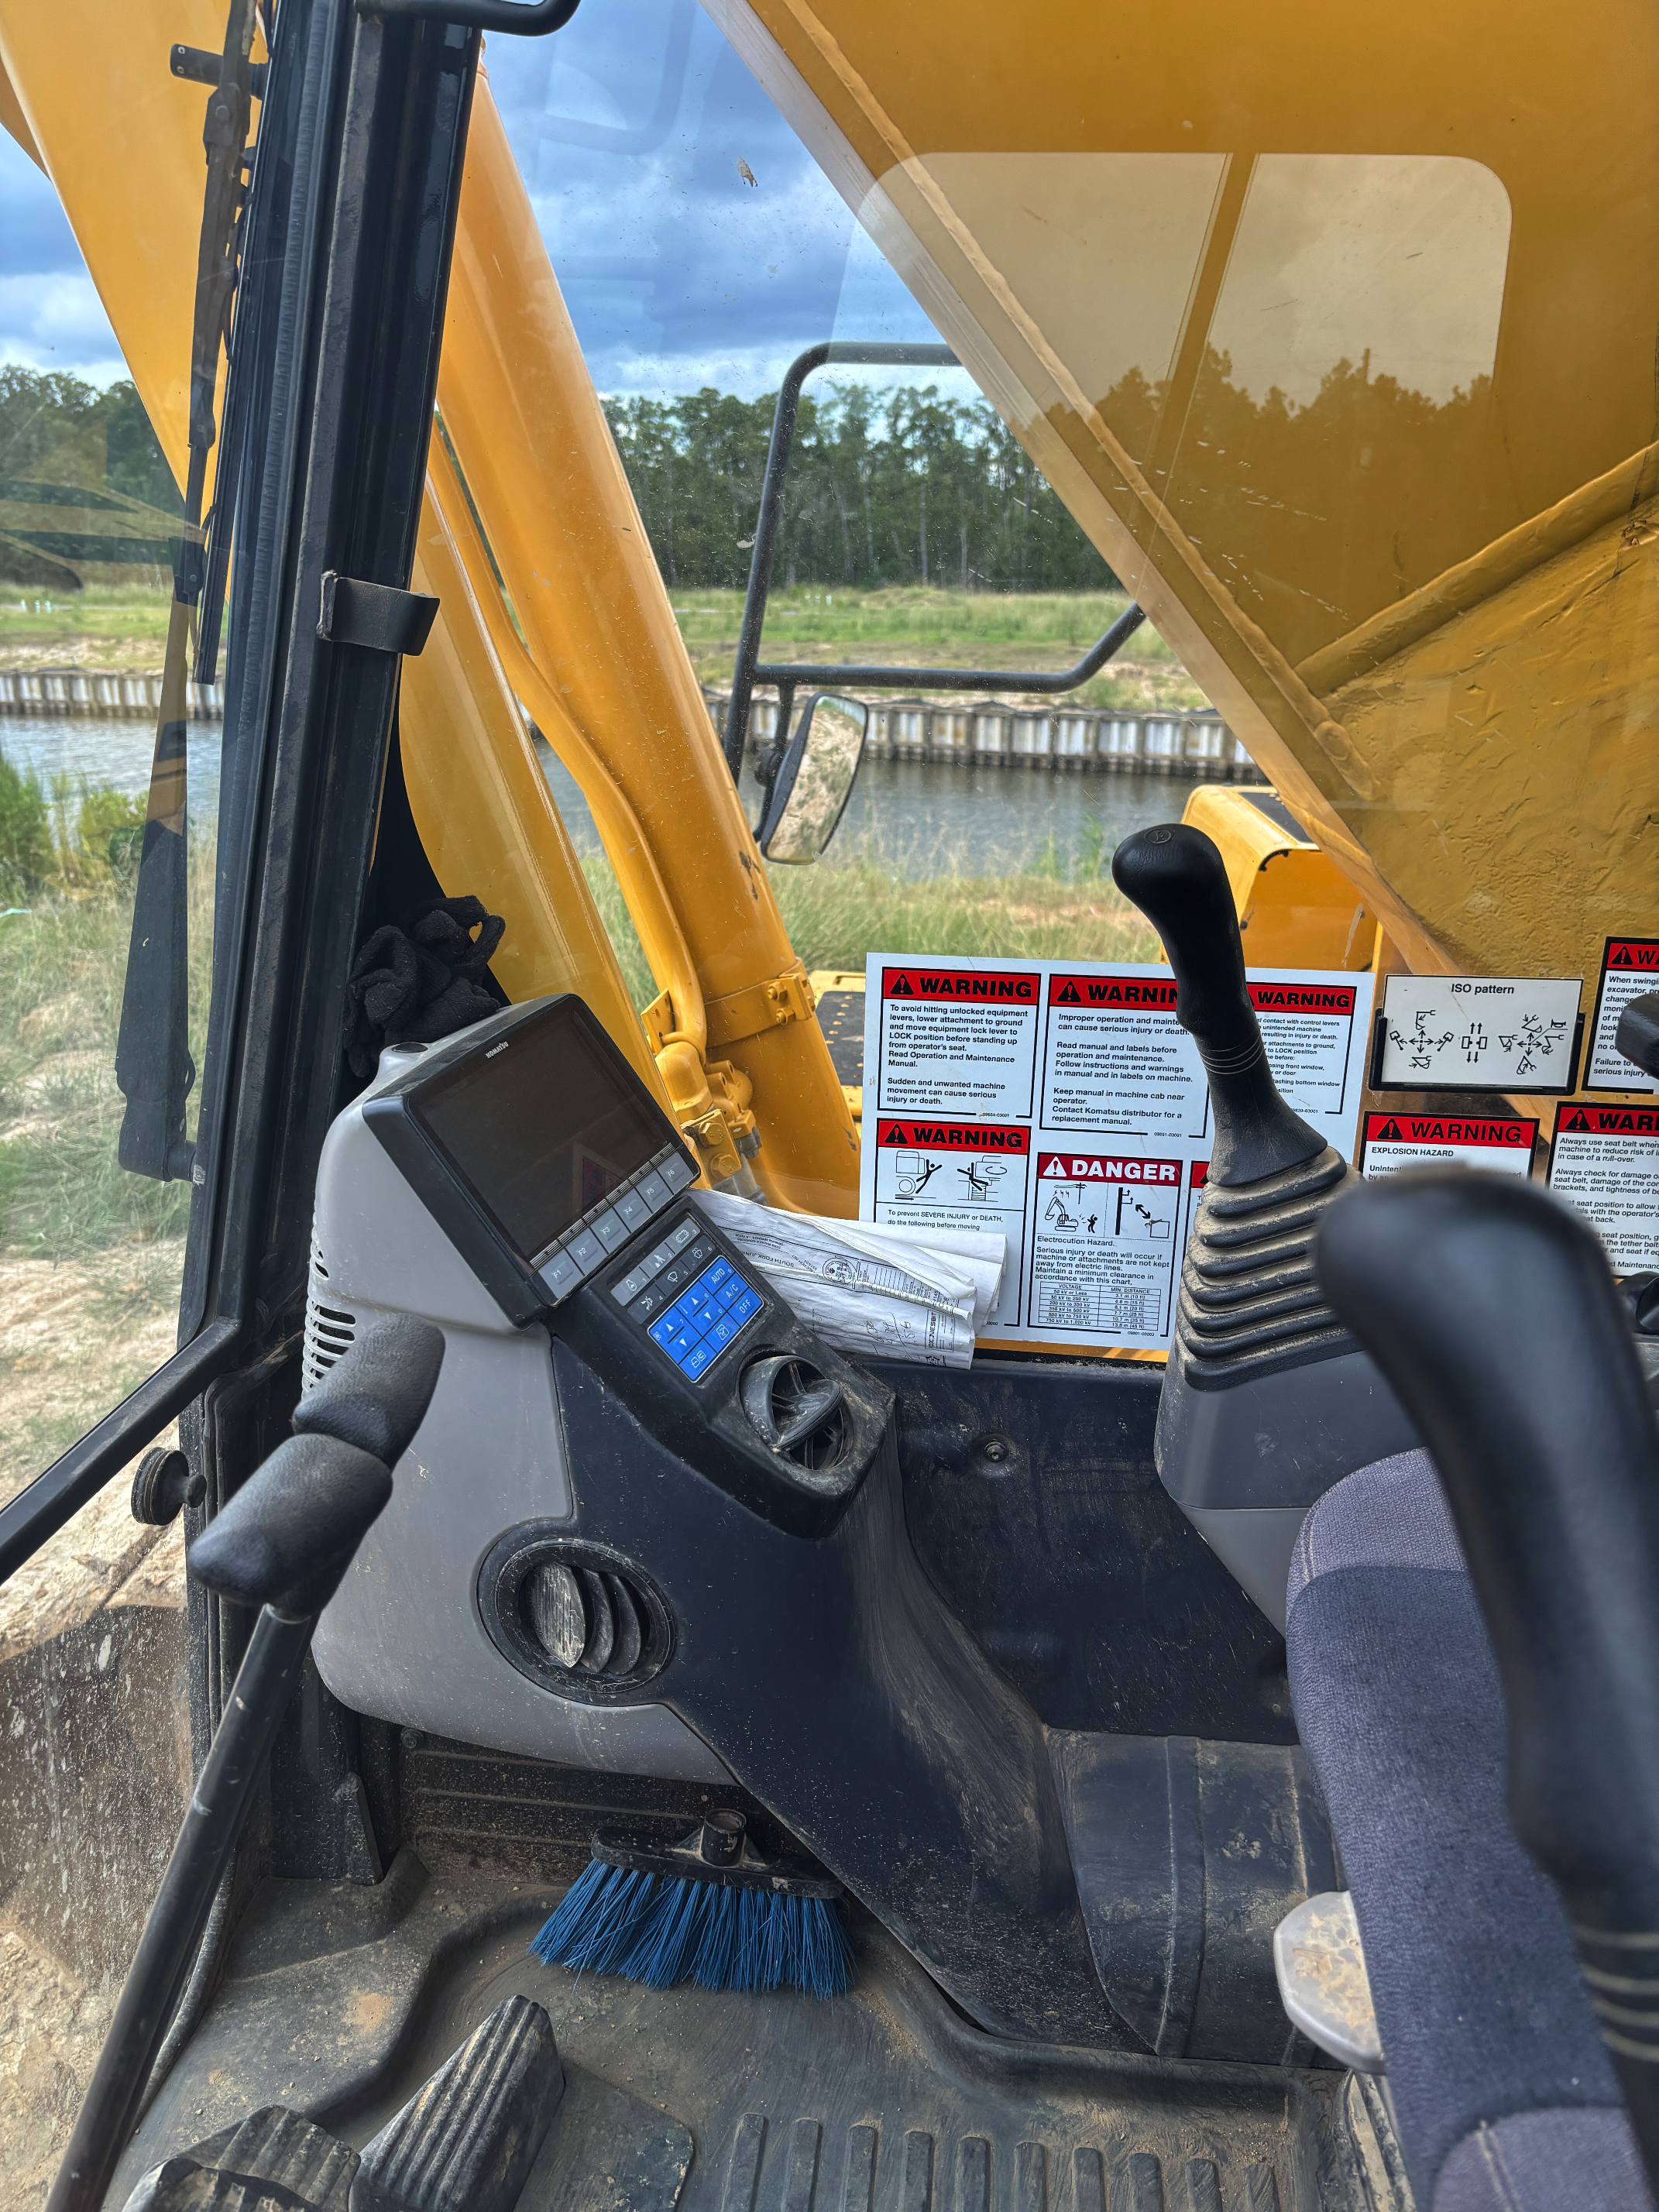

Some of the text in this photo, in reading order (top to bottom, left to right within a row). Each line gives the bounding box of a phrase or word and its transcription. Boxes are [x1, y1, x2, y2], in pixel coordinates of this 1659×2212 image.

[919, 978, 1031, 998] WARNING
[1451, 984, 1514, 995] ISO pattern
[1606, 986, 1647, 994] excavator,
[1087, 985, 1177, 1004] WARNIN
[1256, 991, 1349, 1007] WARNING
[923, 1006, 947, 1015] hitting
[890, 1014, 914, 1022] levers,
[1059, 1014, 1094, 1023] Improper
[928, 1025, 968, 1034] equipment
[1130, 1026, 1152, 1035] injury
[972, 1036, 1005, 1046] standing
[486, 1041, 509, 1058] KOMATSU
[910, 1052, 947, 1060] Operation
[966, 1054, 1015, 1063] Maintenance
[1083, 1061, 1128, 1070] instructions
[1148, 1064, 1183, 1073] warnings
[1623, 1069, 1646, 1077] injury
[1053, 1088, 1073, 1097] Keep
[1410, 1121, 1521, 1142] WARNING
[913, 1128, 1022, 1147] WARNING
[1560, 1138, 1586, 1146] Always
[1372, 1147, 1453, 1157] EXPLOSION HAZARD
[668, 1169, 675, 1177] F6
[1072, 1160, 1175, 1180] DANGER
[1555, 1168, 1582, 1176] Always
[1620, 1171, 1651, 1180] damage
[1037, 1236, 1084, 1245] Electrocution
[579, 1247, 587, 1256] F2
[1066, 1249, 1085, 1257] injury
[1153, 1260, 1170, 1269] kept
[553, 1269, 562, 1278] F1
[711, 1269, 726, 1284] AUTO
[725, 1284, 738, 1298] A/C
[739, 1299, 751, 1314] OFF
